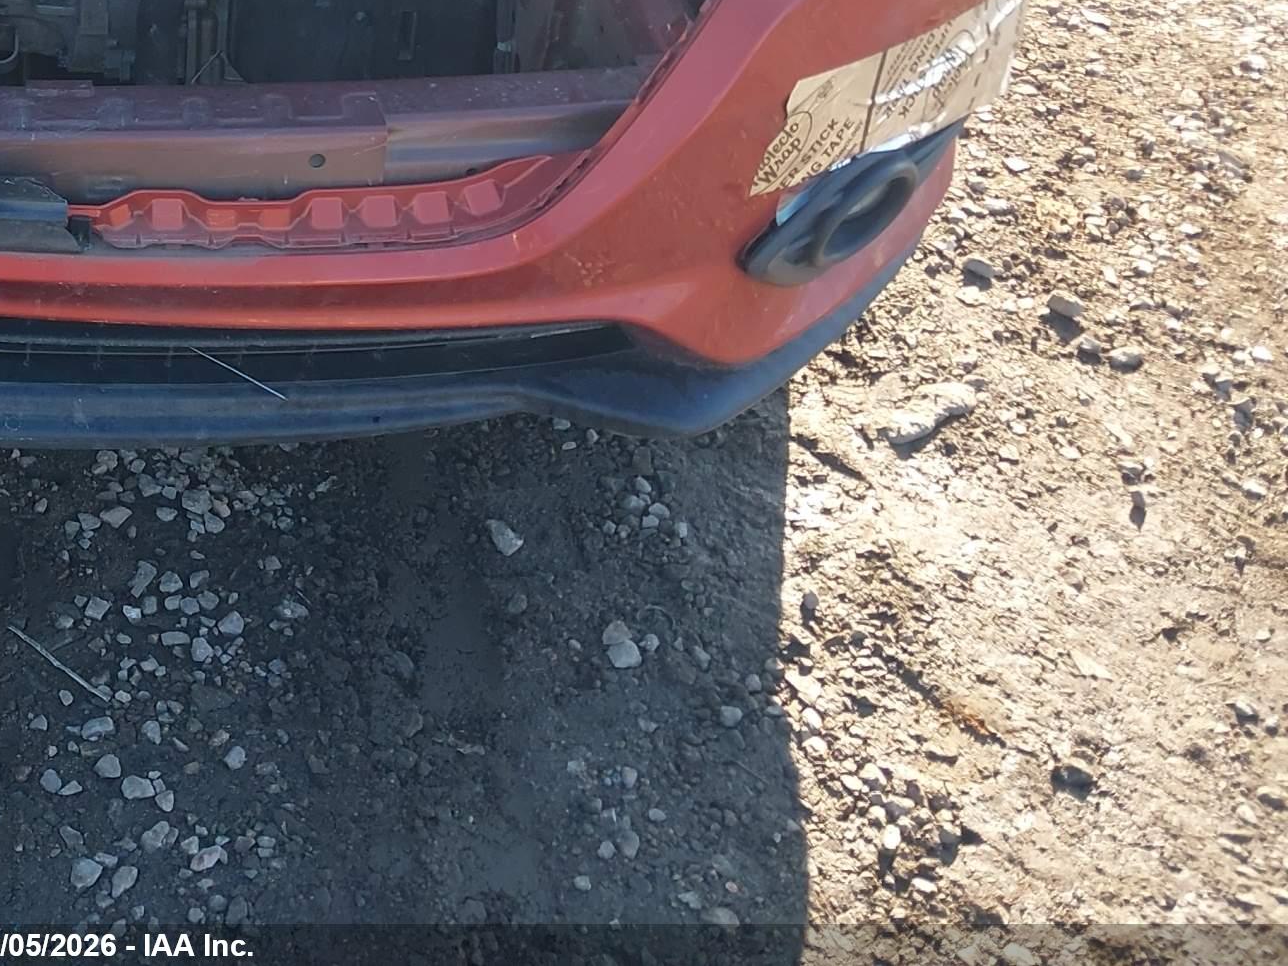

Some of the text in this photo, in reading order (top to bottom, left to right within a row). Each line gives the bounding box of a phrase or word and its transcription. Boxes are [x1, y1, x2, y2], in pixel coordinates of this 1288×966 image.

[757, 137, 801, 184] Wrap
[801, 118, 838, 164] STICK
[821, 117, 854, 158] TAPE
